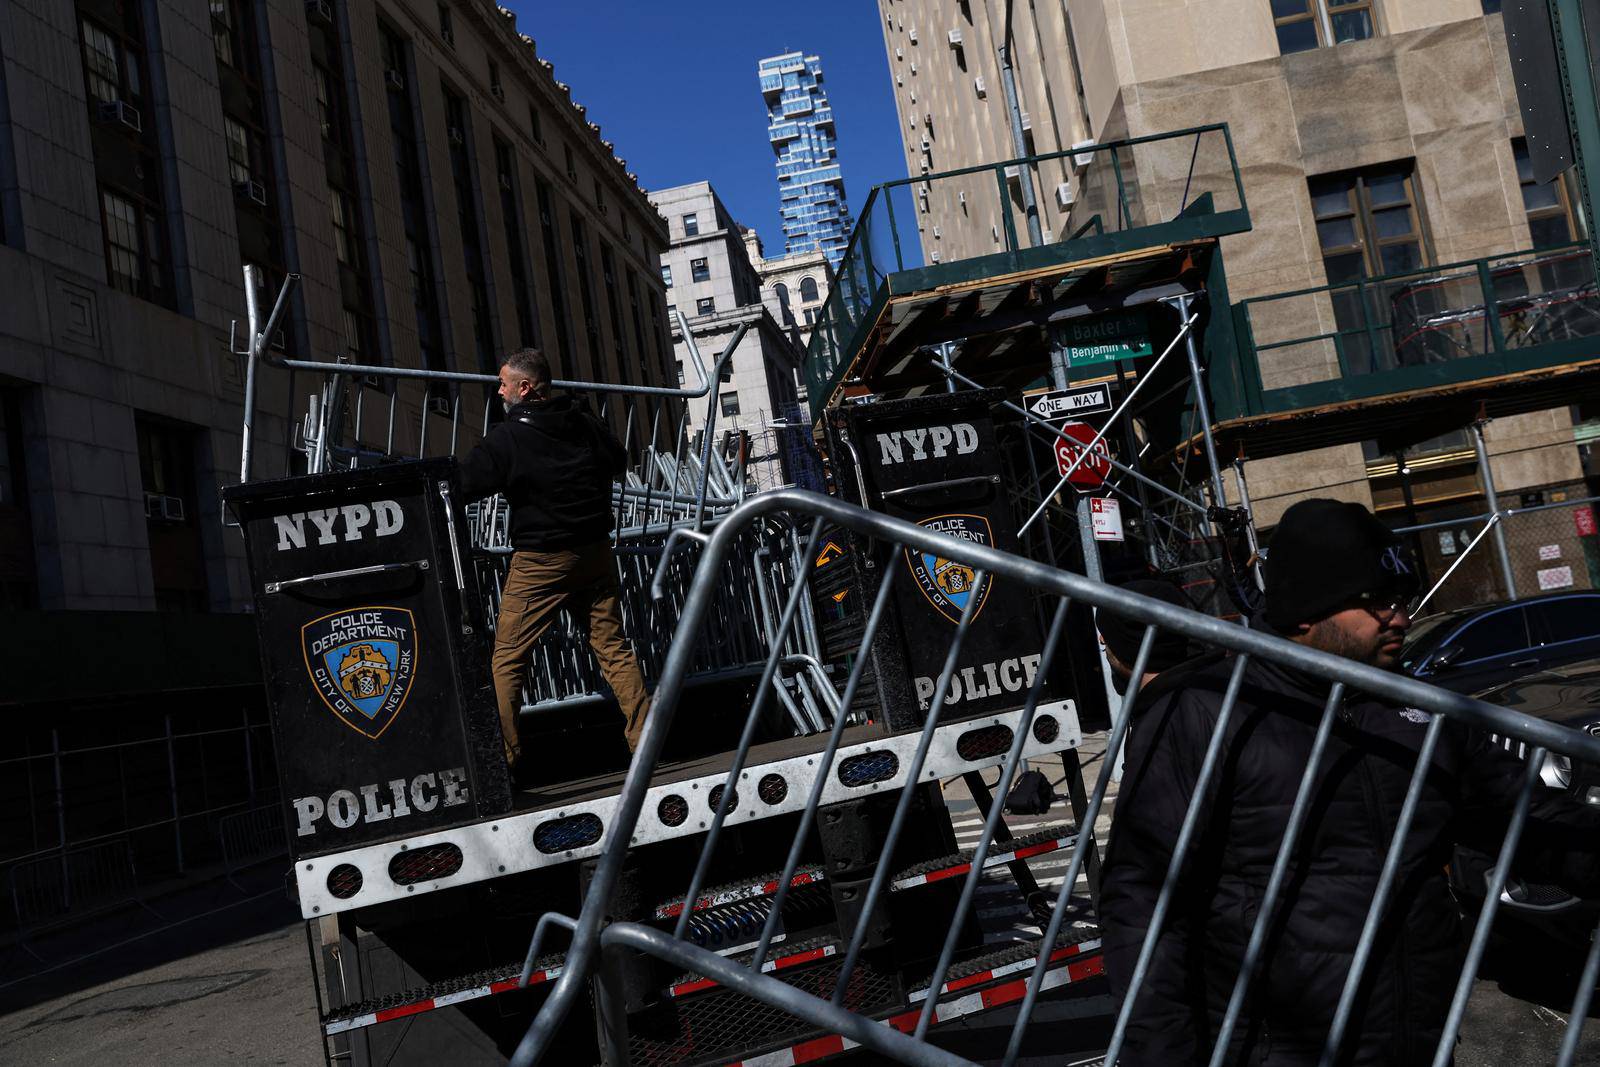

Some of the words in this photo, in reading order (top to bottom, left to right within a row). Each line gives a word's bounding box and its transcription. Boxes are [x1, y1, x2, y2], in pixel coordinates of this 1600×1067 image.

[1072, 320, 1120, 340] Baxter
[1071, 343, 1119, 359] Benjamin
[1038, 399, 1063, 413] ONE
[1072, 393, 1097, 407] WAY
[876, 423, 980, 466] NYPD
[1059, 443, 1106, 472] STOP
[273, 500, 405, 551] NYPD
[915, 566, 935, 592] CITY
[933, 593, 948, 607] OF
[330, 612, 384, 632] POLICE
[312, 625, 407, 656] DEPARTMENT
[315, 668, 338, 697] CITY
[334, 698, 353, 714] OF
[384, 683, 405, 713] NEW
[398, 649, 411, 680] YORK
[292, 767, 469, 837] POLICE
